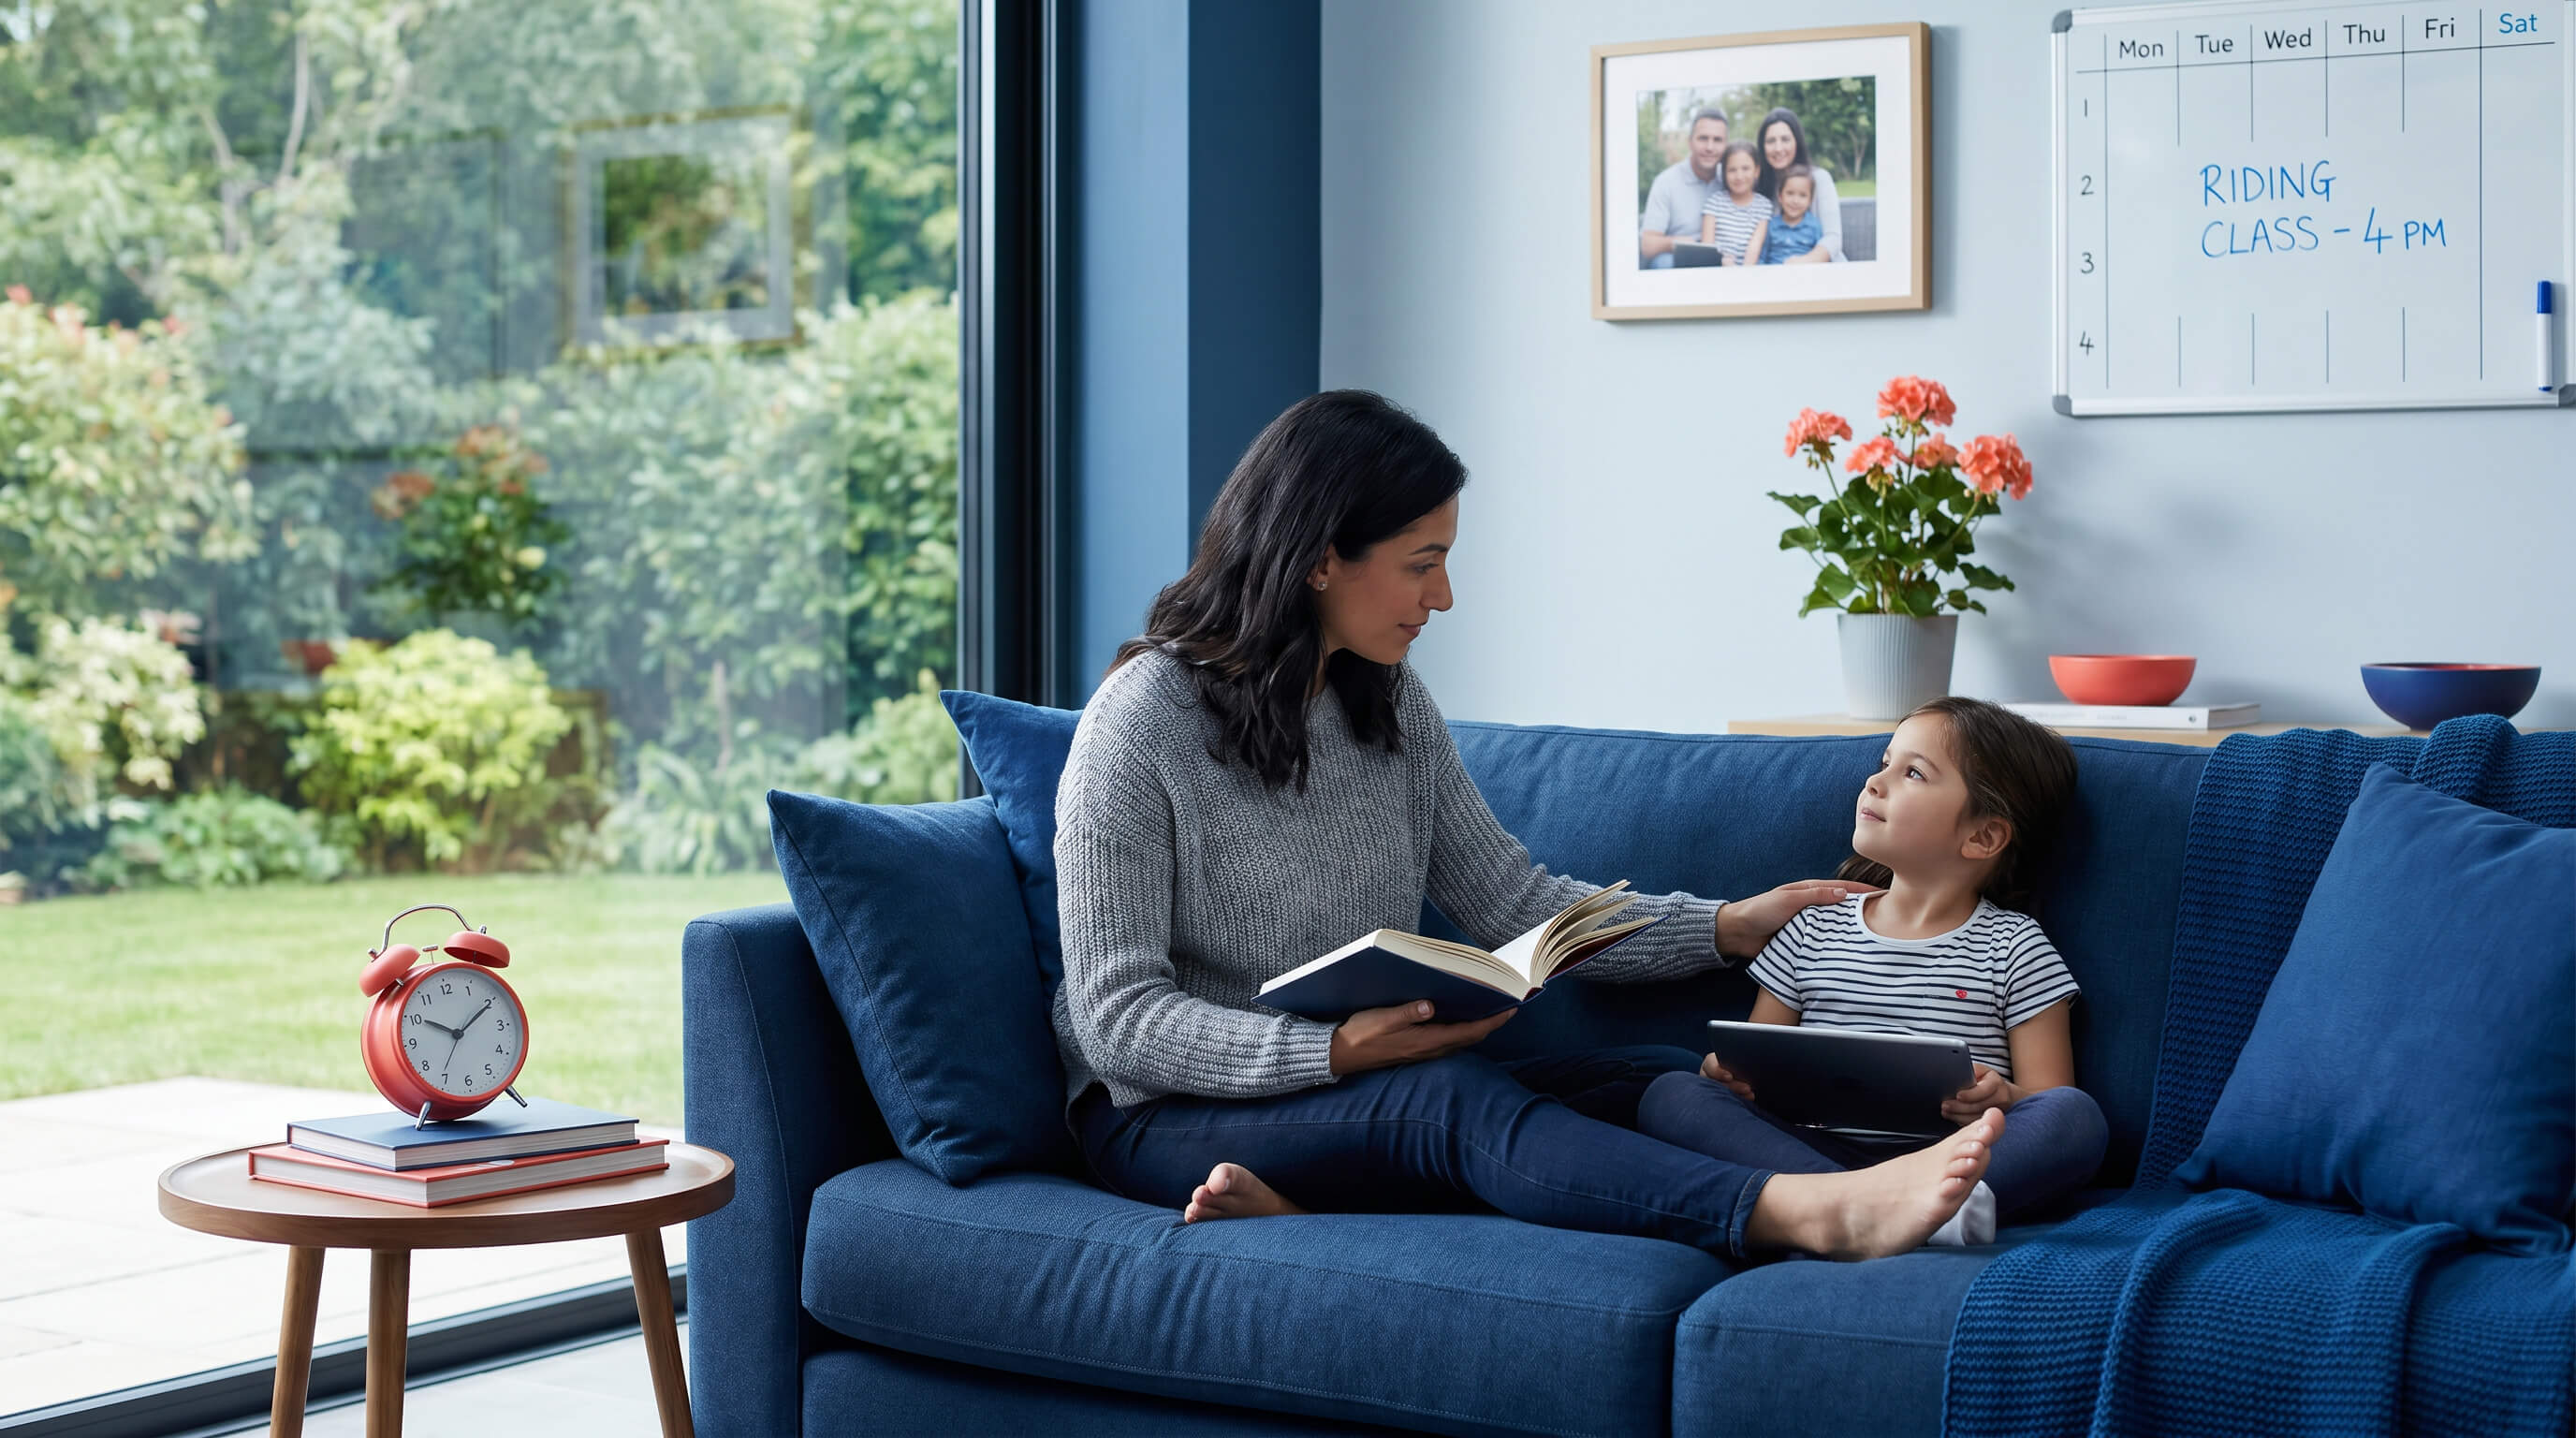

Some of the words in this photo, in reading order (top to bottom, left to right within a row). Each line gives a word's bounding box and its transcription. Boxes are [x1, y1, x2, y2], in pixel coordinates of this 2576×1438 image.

[2118, 39, 2164, 59] Mon
[2195, 34, 2233, 54] Tue
[2263, 27, 2312, 50] Wed
[2342, 23, 2386, 45] Thu
[2424, 17, 2455, 39] Fri
[2498, 12, 2538, 35] Sat
[2080, 174, 2095, 197] 2
[2199, 159, 2337, 207] RIDING
[2201, 215, 2320, 258] CLASS
[2363, 207, 2393, 255] 4
[2404, 218, 2447, 250] PM
[2080, 252, 2096, 274] 3
[2079, 330, 2096, 356] 4
[440, 983, 454, 995] 12
[465, 985, 472, 996] 1
[421, 994, 432, 1006] 11
[483, 998, 492, 1010] 2
[409, 1013, 422, 1026] 10
[496, 1019, 505, 1032] 3
[408, 1037, 417, 1049] 9
[495, 1044, 504, 1055] 4
[421, 1060, 431, 1071] 8
[484, 1063, 492, 1075] 5
[441, 1073, 449, 1085] 7
[464, 1074, 474, 1087] 6
